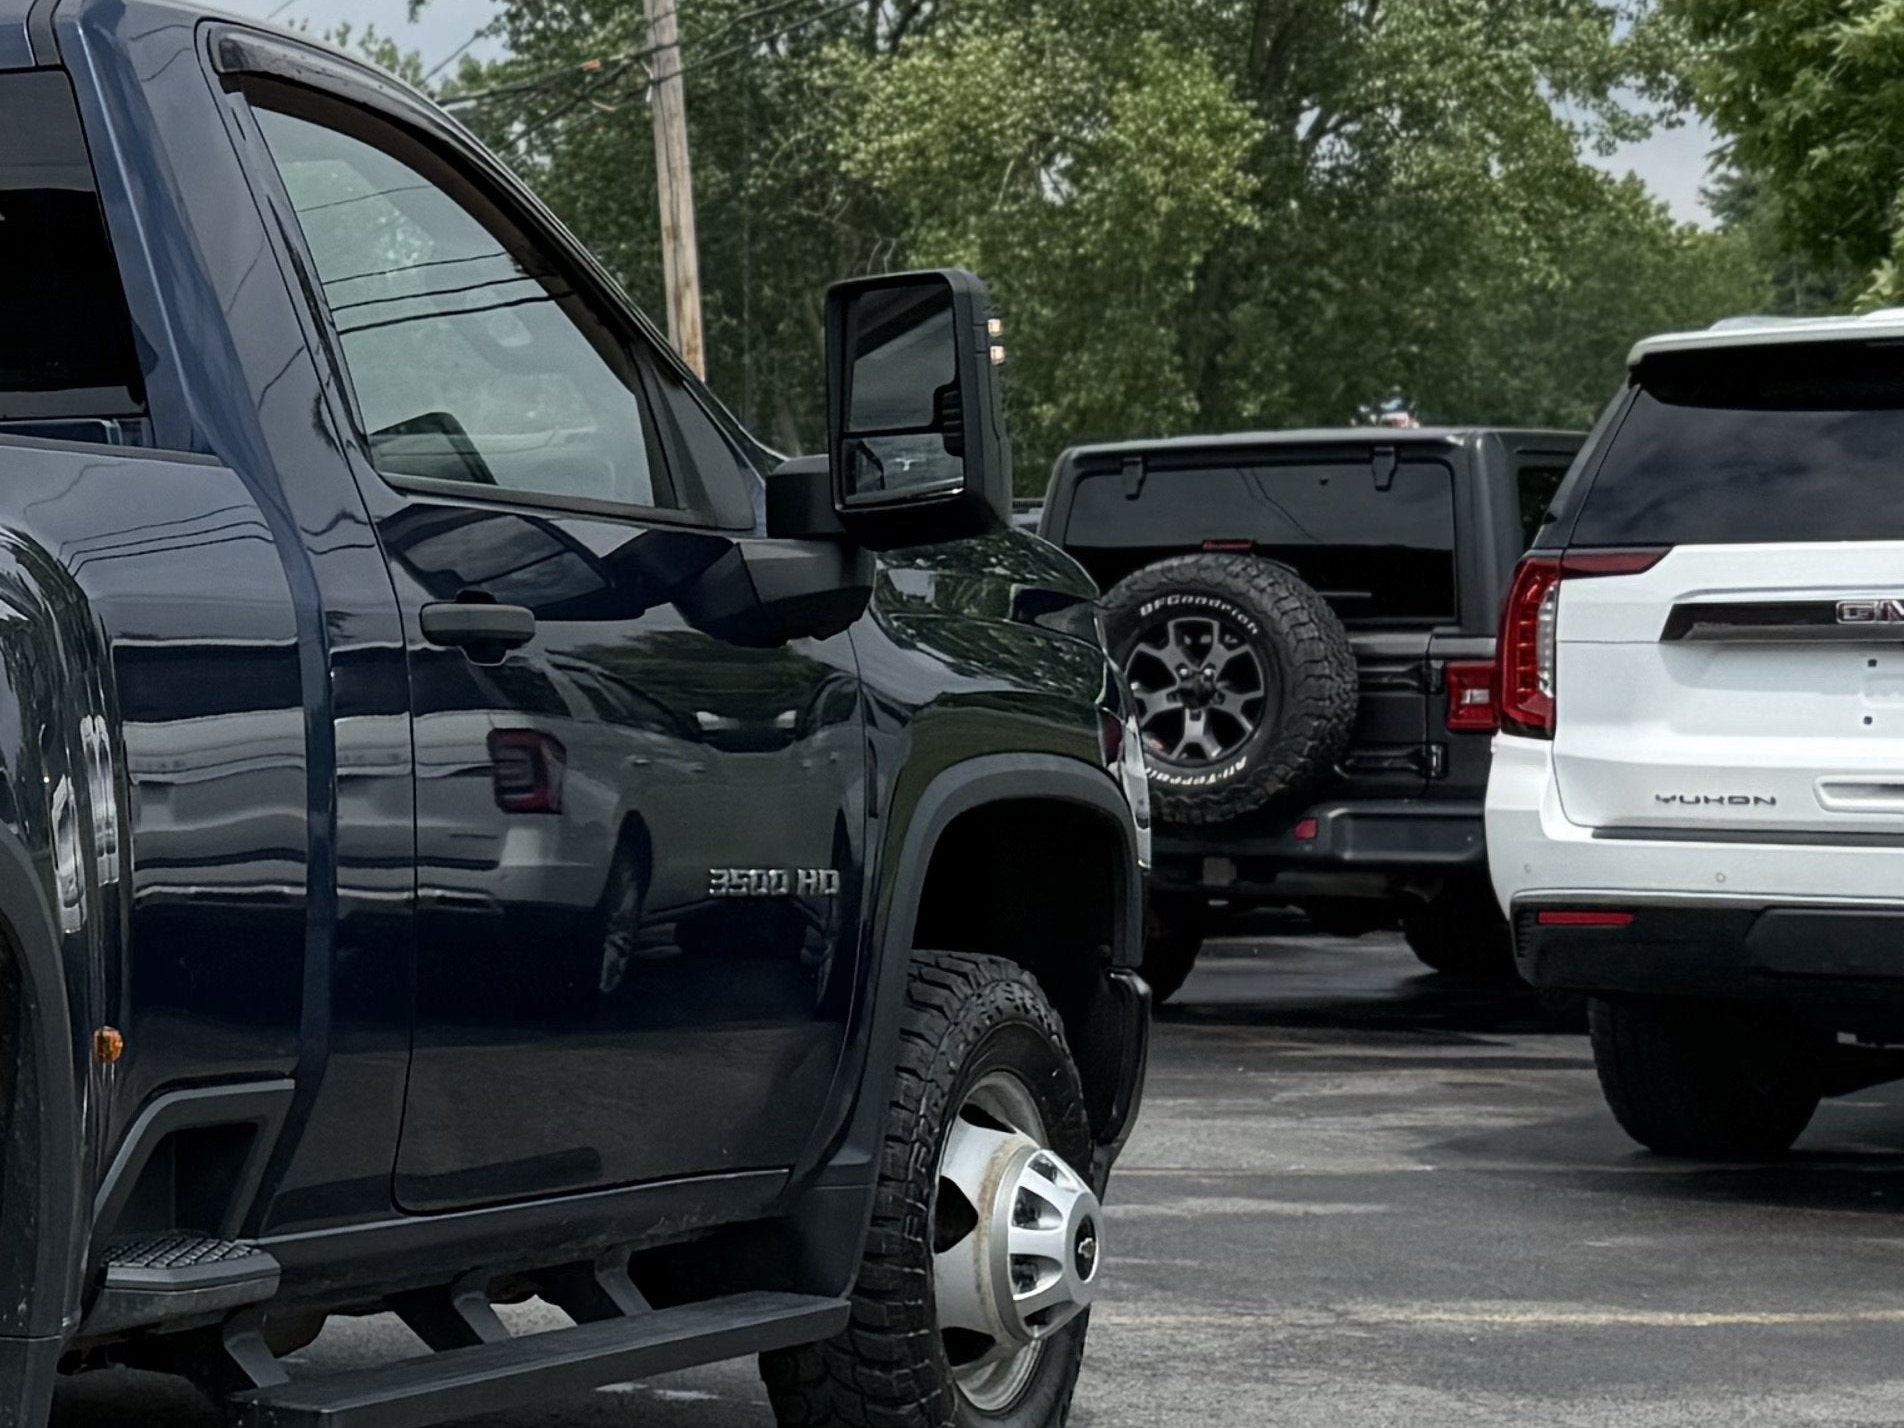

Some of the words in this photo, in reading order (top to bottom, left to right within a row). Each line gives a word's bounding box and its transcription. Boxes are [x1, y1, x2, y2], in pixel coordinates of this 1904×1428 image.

[1139, 594, 1259, 636] BFGoodrich
[1654, 793, 1777, 807] YUKON
[708, 868, 789, 897] 3500
[797, 868, 840, 897] HD
